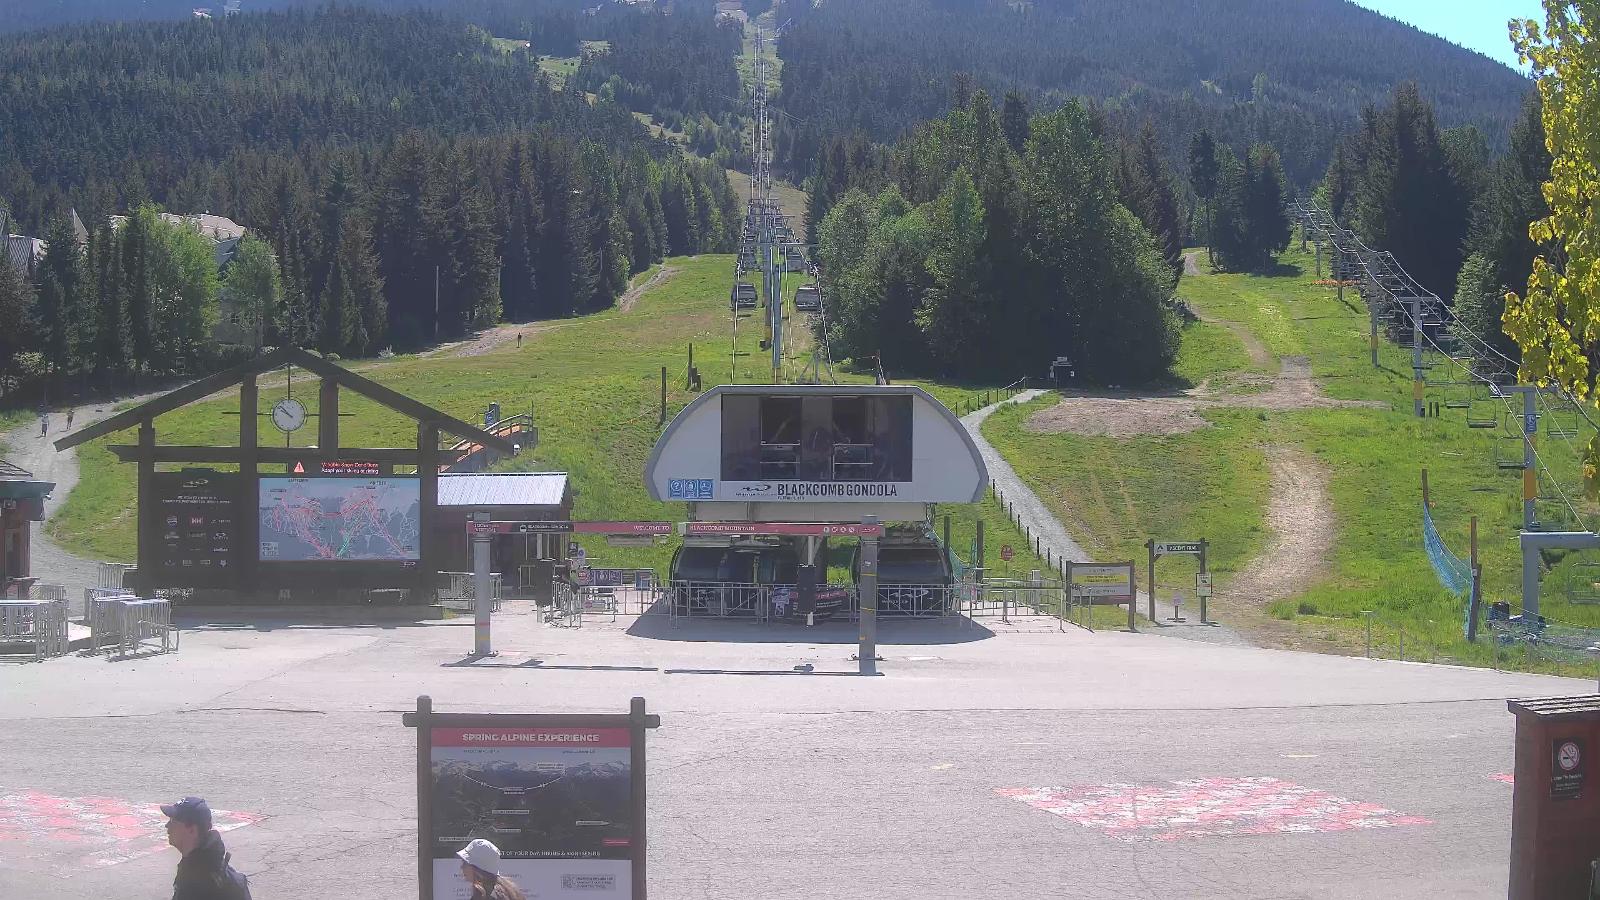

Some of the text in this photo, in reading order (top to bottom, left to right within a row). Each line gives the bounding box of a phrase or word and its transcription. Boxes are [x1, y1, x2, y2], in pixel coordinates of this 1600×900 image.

[777, 483, 897, 497] BLACKCOMB GONDOLA
[462, 733, 600, 742] SPRING ALPINE EXPERIENCE
